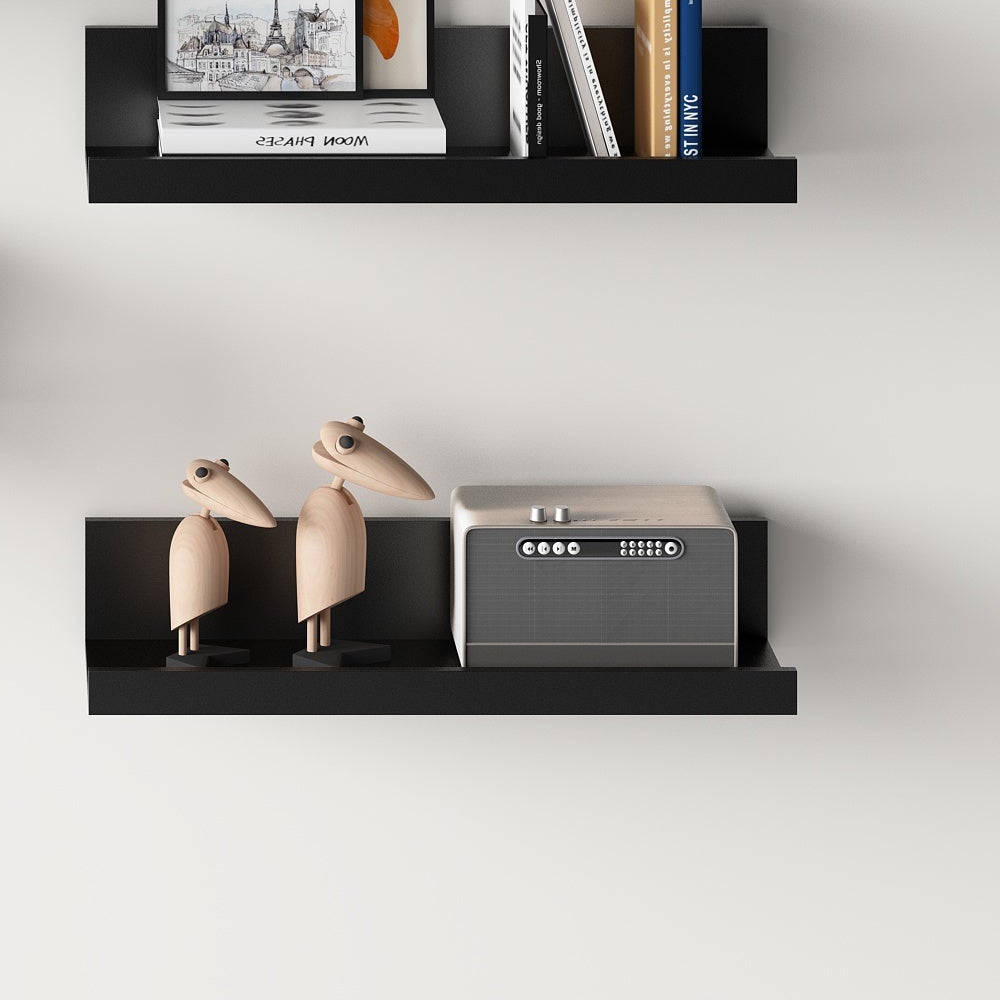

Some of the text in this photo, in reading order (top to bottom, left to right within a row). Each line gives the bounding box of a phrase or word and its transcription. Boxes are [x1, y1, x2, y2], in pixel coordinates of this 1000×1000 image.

[683, 94, 699, 156] ST IN NYC
